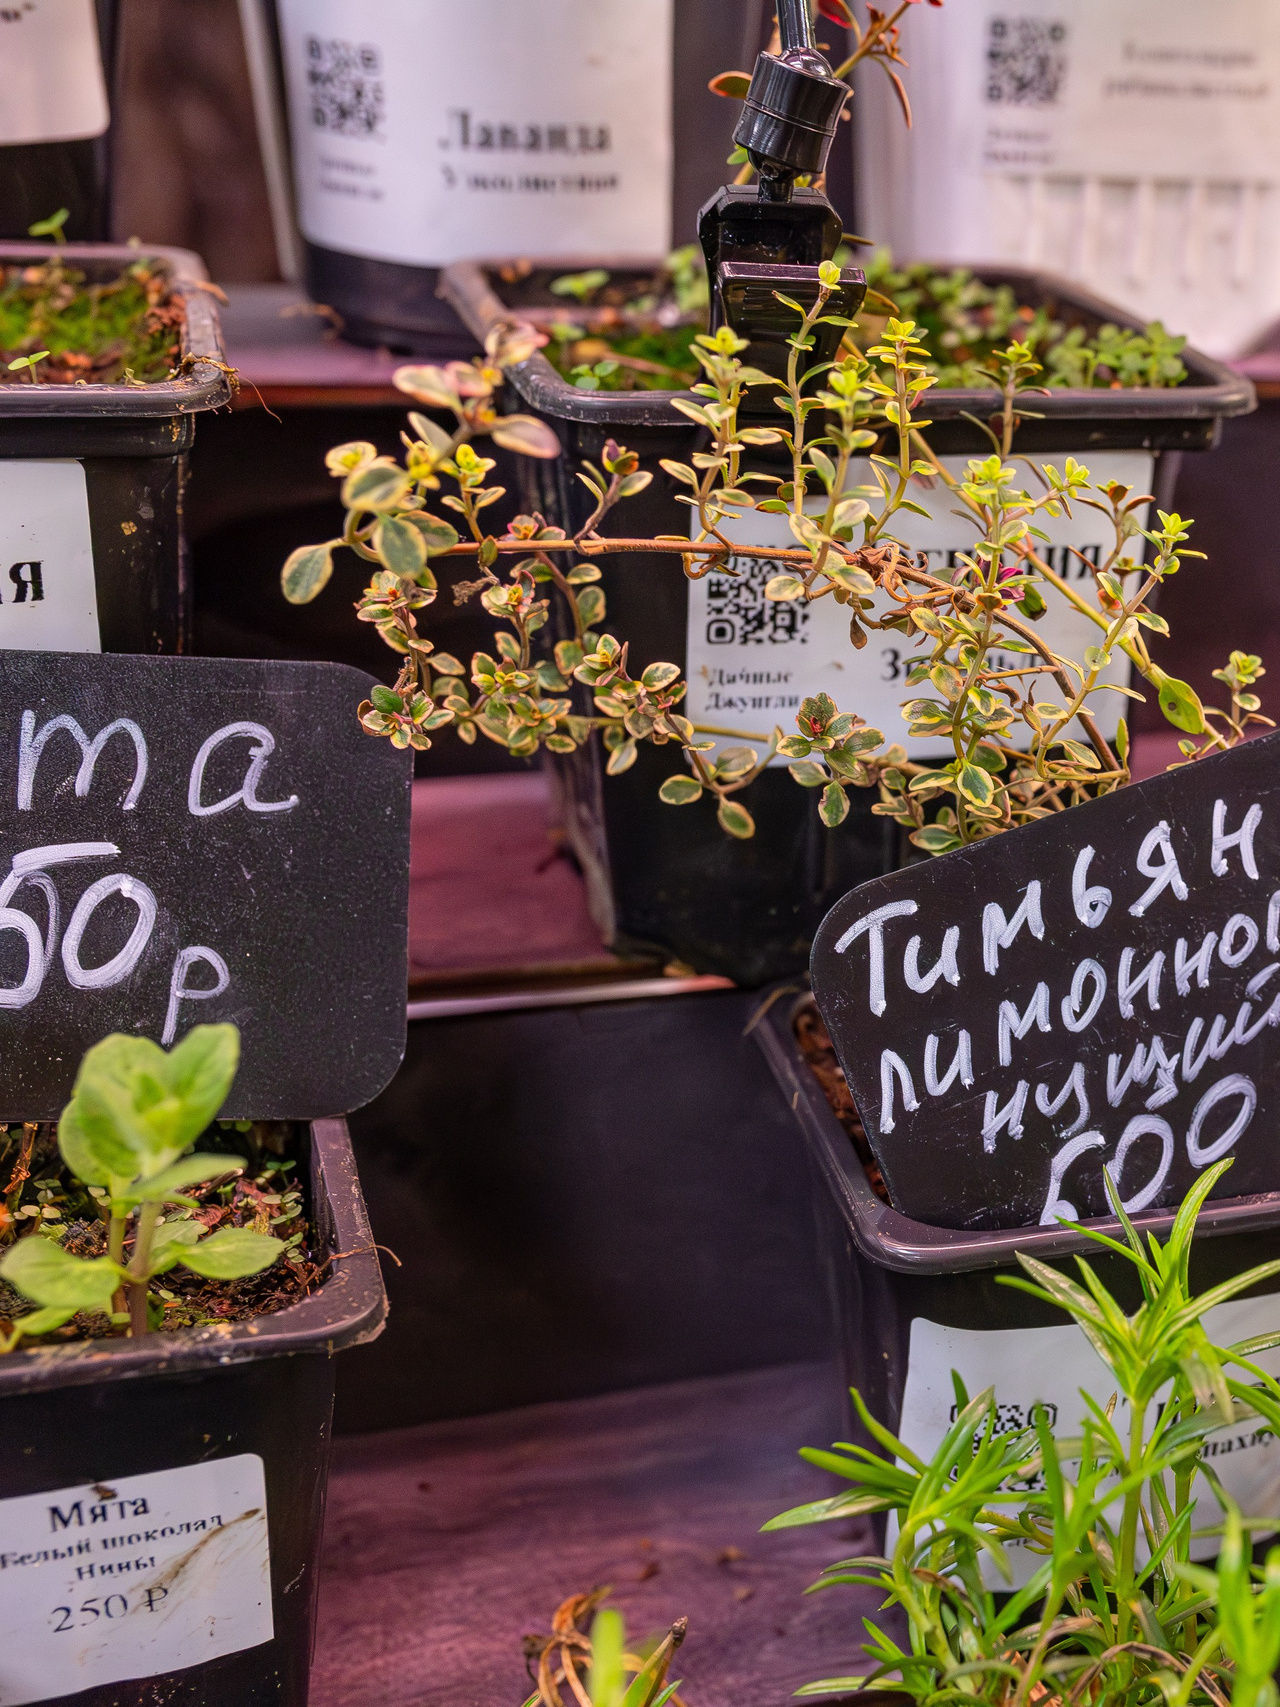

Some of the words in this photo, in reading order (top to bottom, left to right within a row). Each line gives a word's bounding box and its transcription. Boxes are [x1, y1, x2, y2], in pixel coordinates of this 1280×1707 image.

[704, 692, 800, 713] Джунгли
[49, 1497, 150, 1533] Мята
[0, 1537, 91, 1570] Белый
[101, 1515, 224, 1550] шоколад
[76, 1556, 156, 1581] Нины
[50, 1594, 129, 1633] 250
